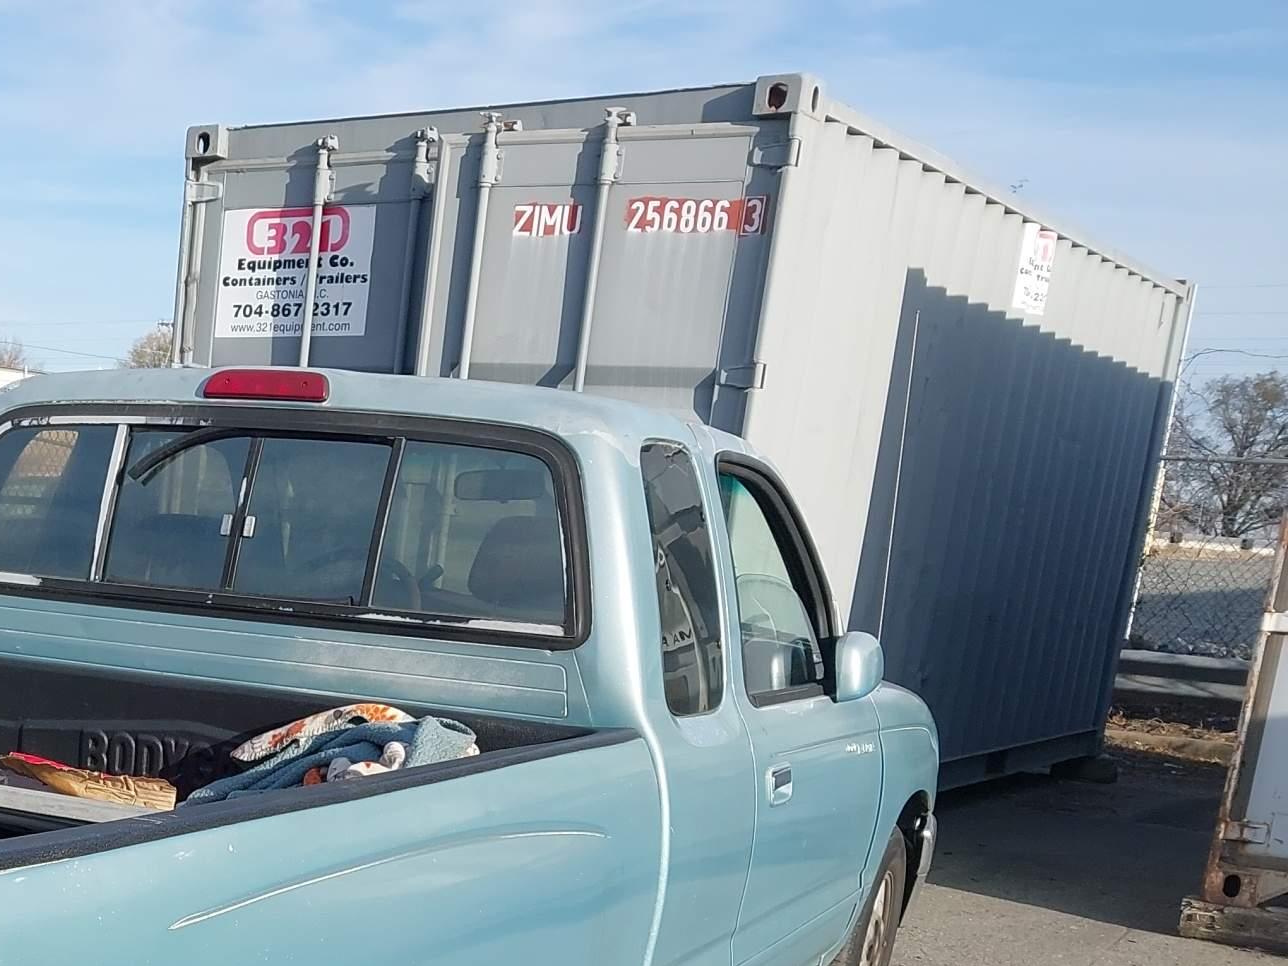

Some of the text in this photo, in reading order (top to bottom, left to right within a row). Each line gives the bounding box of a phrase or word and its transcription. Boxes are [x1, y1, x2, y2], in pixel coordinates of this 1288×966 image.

[512, 199, 763, 236] ZIMU 256866 3
[329, 255, 355, 268] Co.
[222, 275, 297, 287] Containers
[315, 272, 368, 285] railers
